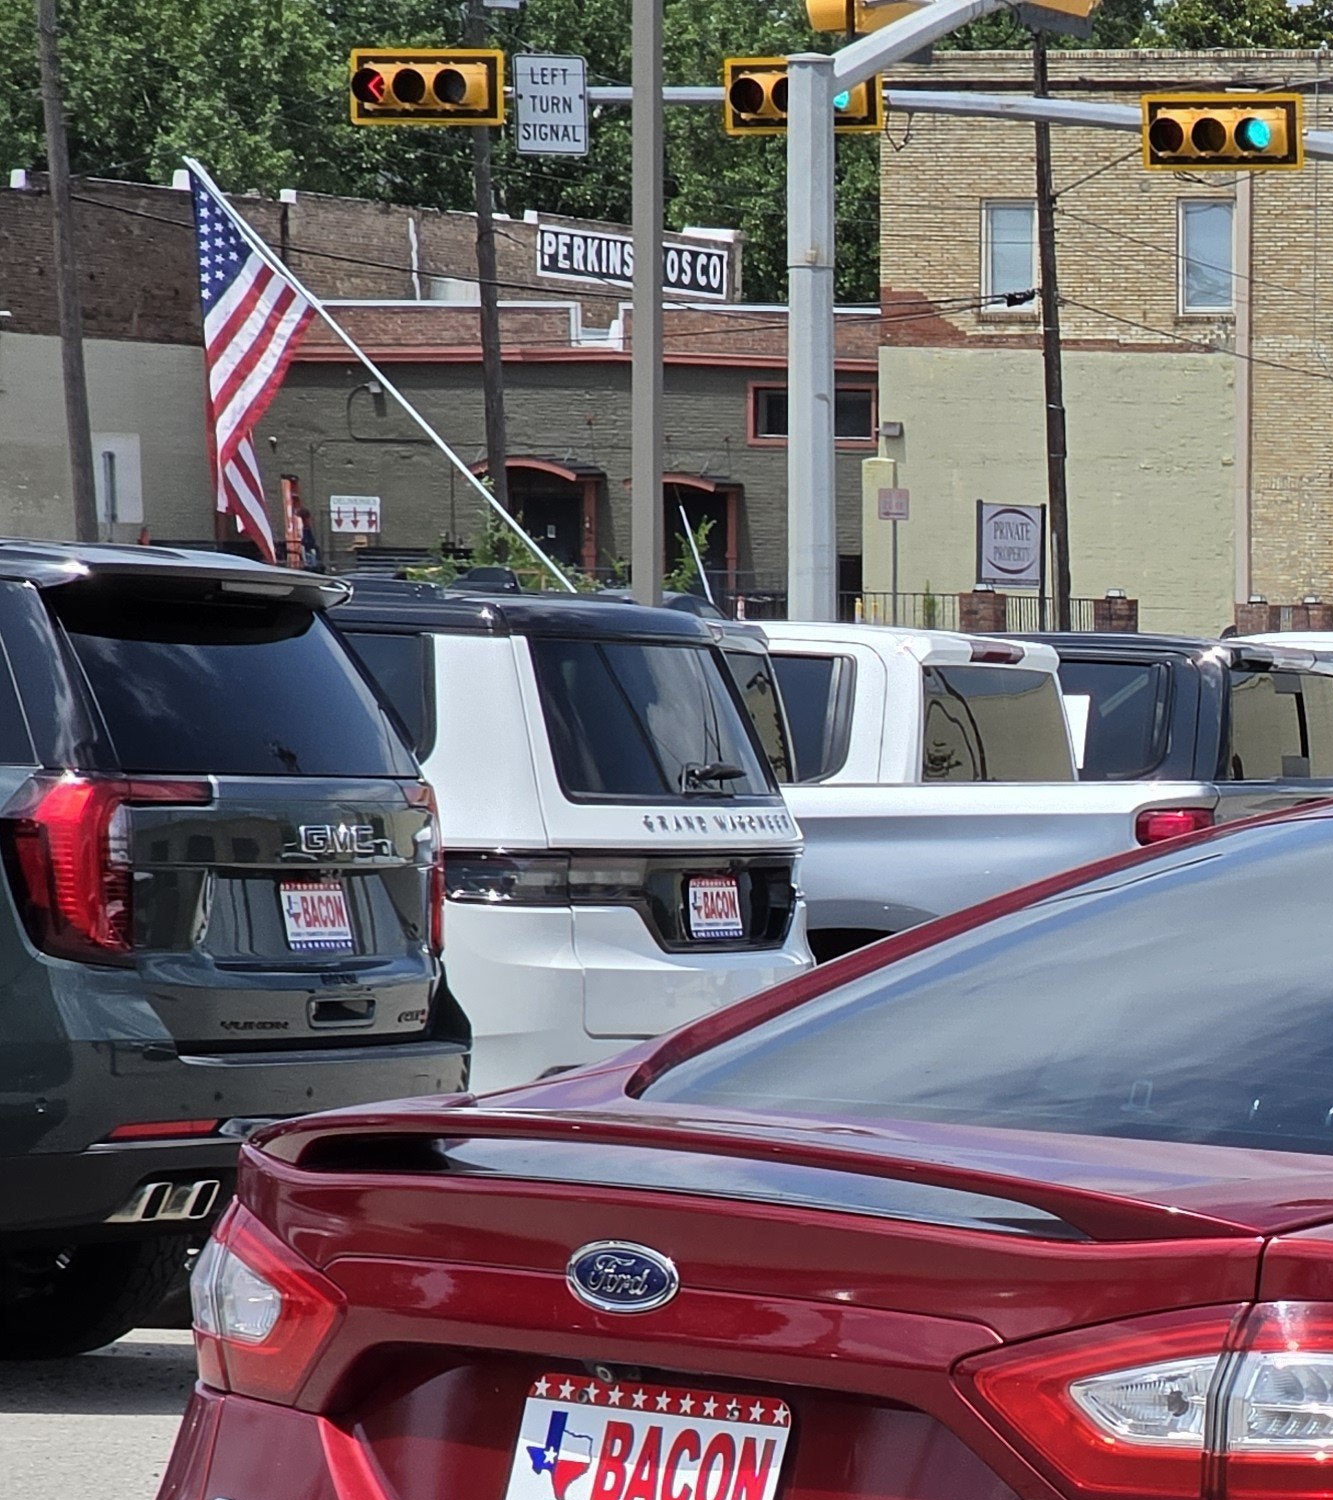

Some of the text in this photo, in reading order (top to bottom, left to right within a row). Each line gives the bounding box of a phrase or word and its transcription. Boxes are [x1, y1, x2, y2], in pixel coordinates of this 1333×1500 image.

[530, 67, 569, 85] LEFT
[529, 95, 572, 114] TURN
[522, 124, 581, 142] SIGNAL
[543, 231, 634, 276] PERKINS
[696, 253, 721, 289] CO
[993, 521, 1031, 541] PRIVATE
[993, 546, 1031, 562] PROPERTY
[643, 814, 708, 832] GRAND
[299, 825, 376, 853] GMC
[301, 895, 347, 927] BACON
[703, 891, 738, 919] BACON
[588, 1253, 650, 1297] Ford
